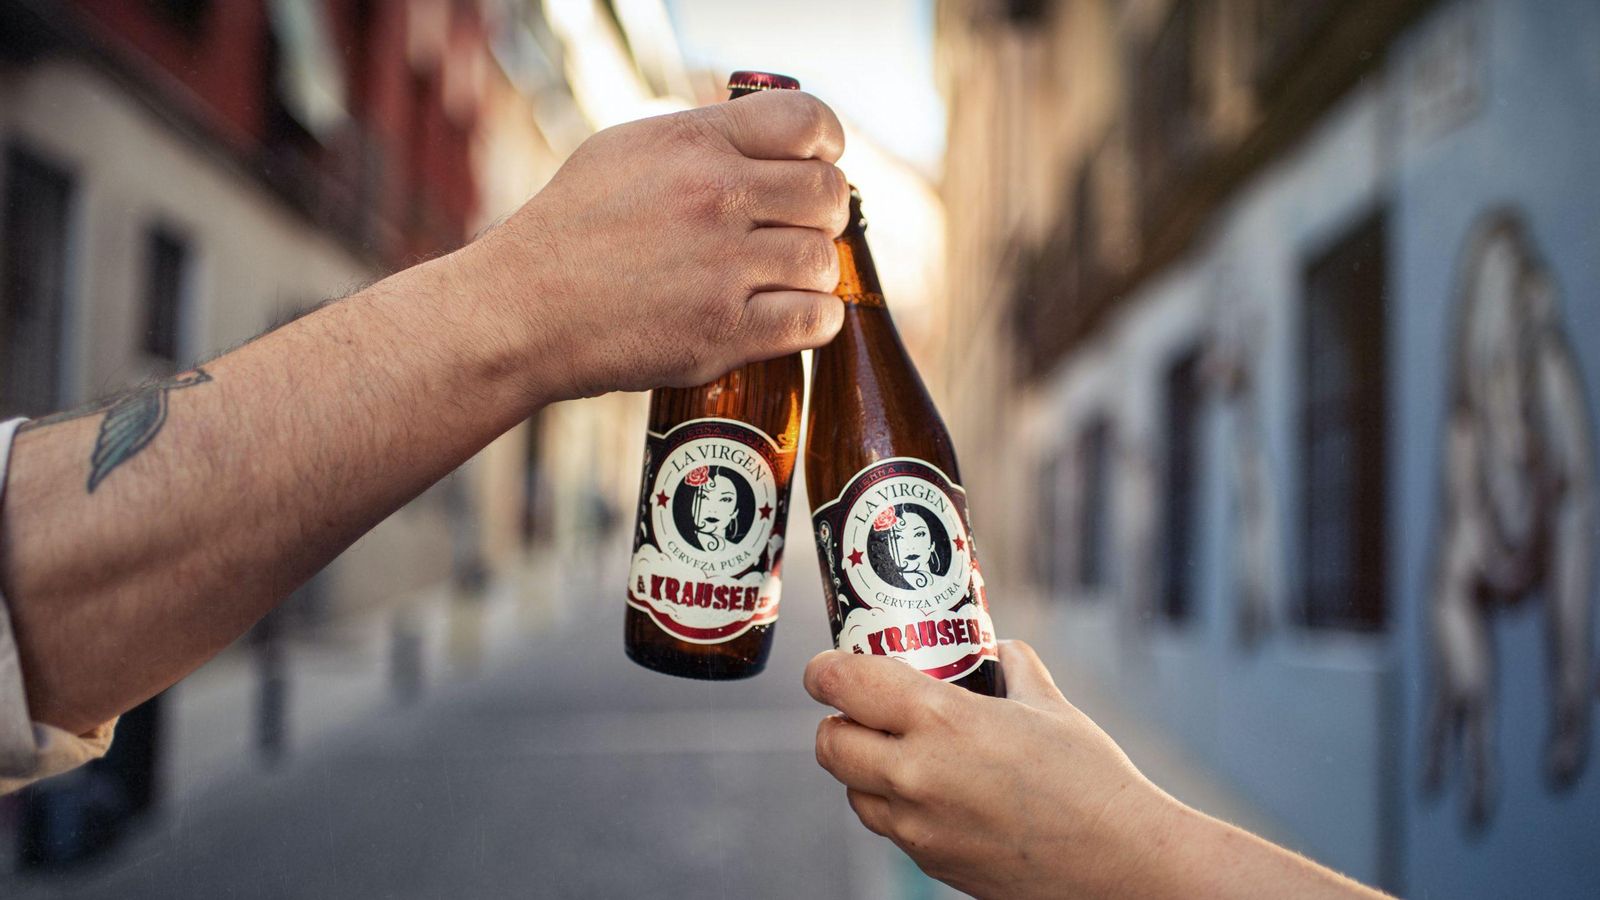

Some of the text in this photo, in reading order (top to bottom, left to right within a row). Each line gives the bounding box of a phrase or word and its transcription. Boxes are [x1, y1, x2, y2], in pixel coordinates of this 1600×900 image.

[671, 444, 766, 482] LA VIRGEN
[854, 483, 949, 525] LA VIRGEN
[667, 540, 752, 572] CERVEZA PURA
[650, 574, 760, 612] KRAUSEN
[875, 582, 961, 609] CERVEZA PURA
[867, 618, 981, 656] KRAUSEN
